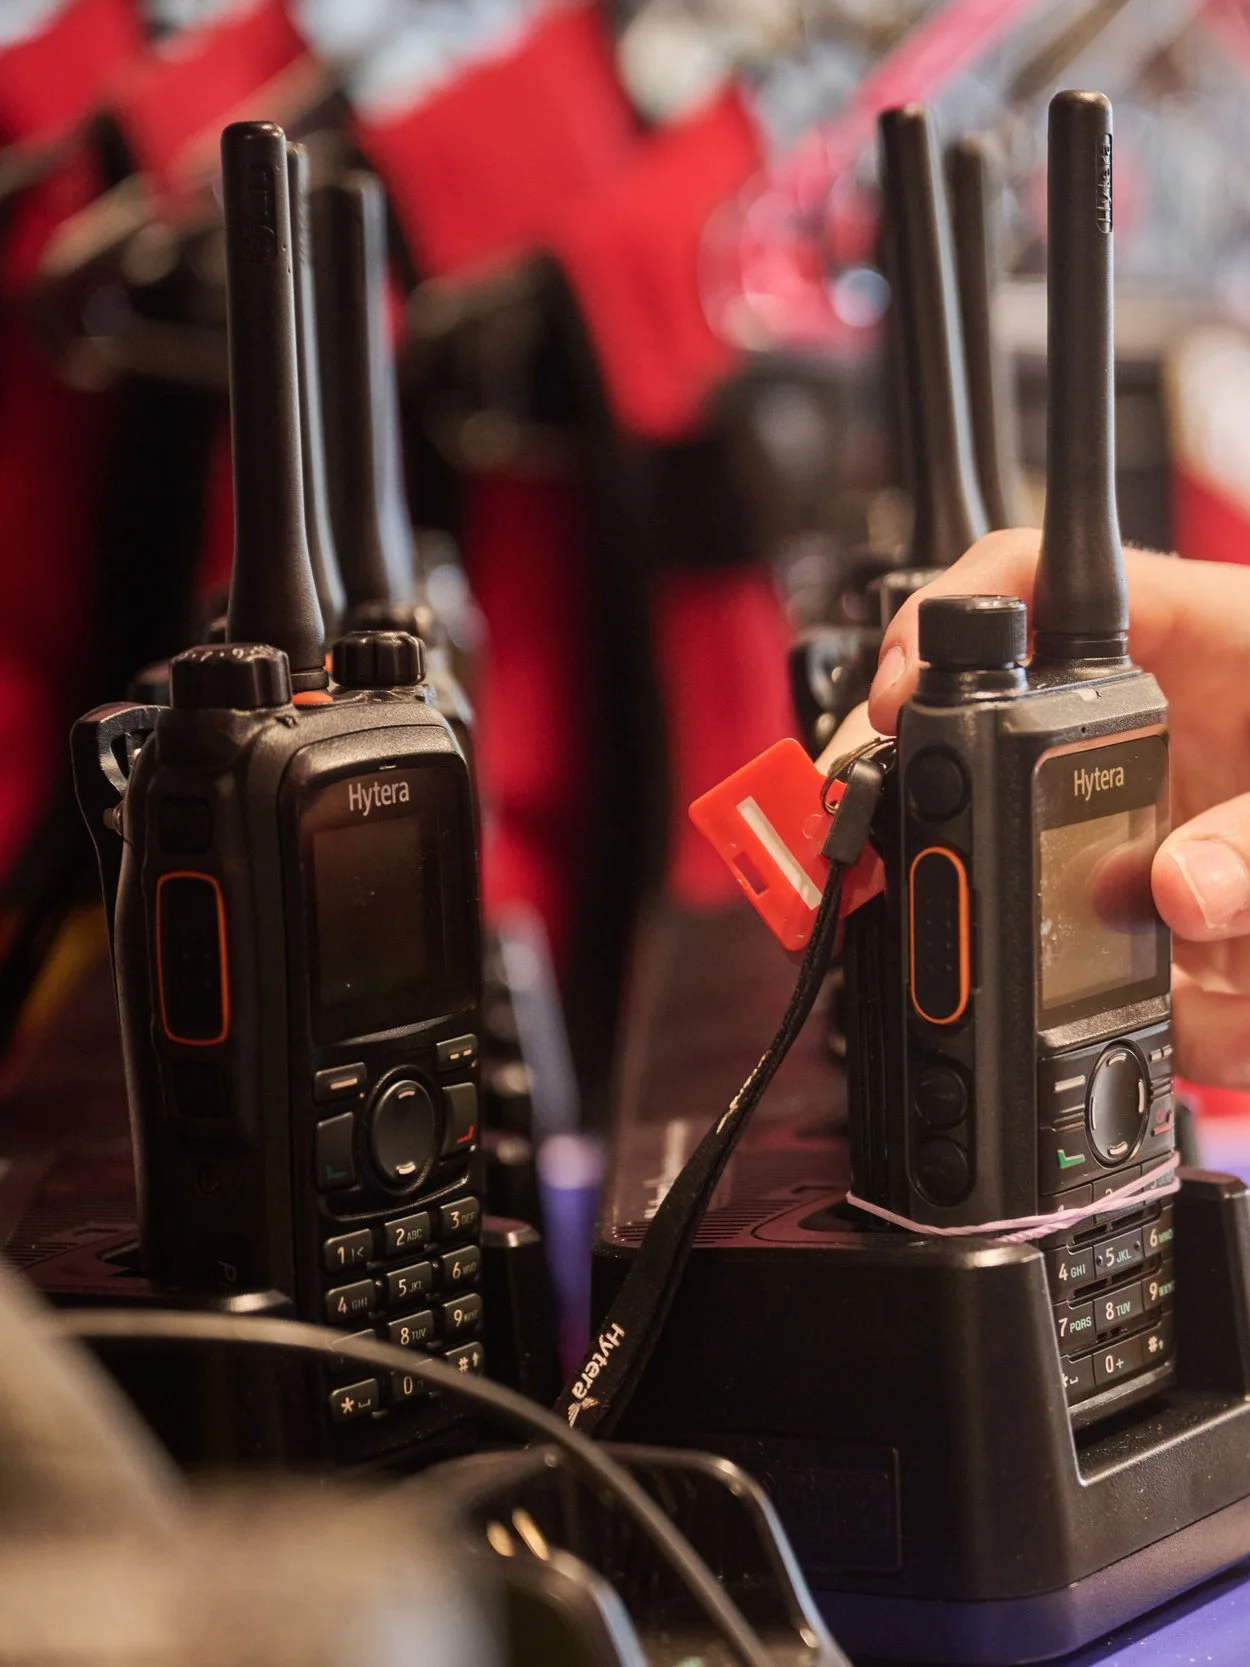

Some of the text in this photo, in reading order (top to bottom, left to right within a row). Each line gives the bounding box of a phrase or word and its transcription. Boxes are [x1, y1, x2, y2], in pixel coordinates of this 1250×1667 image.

[1073, 766, 1124, 801] Hytera
[348, 781, 410, 817] Hytera
[450, 1211, 460, 1229] 3
[395, 1228, 422, 1246] 2 ABC
[1149, 1228, 1158, 1248] 6
[337, 1246, 345, 1264] 1
[1105, 1247, 1132, 1267] 5 JKL
[452, 1261, 461, 1279] 6
[1058, 1262, 1086, 1281] 4 GHI
[398, 1278, 407, 1297] 5
[1149, 1282, 1158, 1301] 9
[337, 1296, 348, 1315] 4
[1105, 1301, 1131, 1321] 8 TUV
[453, 1309, 463, 1327] 9
[1058, 1316, 1092, 1337] 7 PQRS
[400, 1327, 427, 1345] 8 TUV
[571, 1322, 625, 1399] Hytera
[1105, 1355, 1114, 1374] 0
